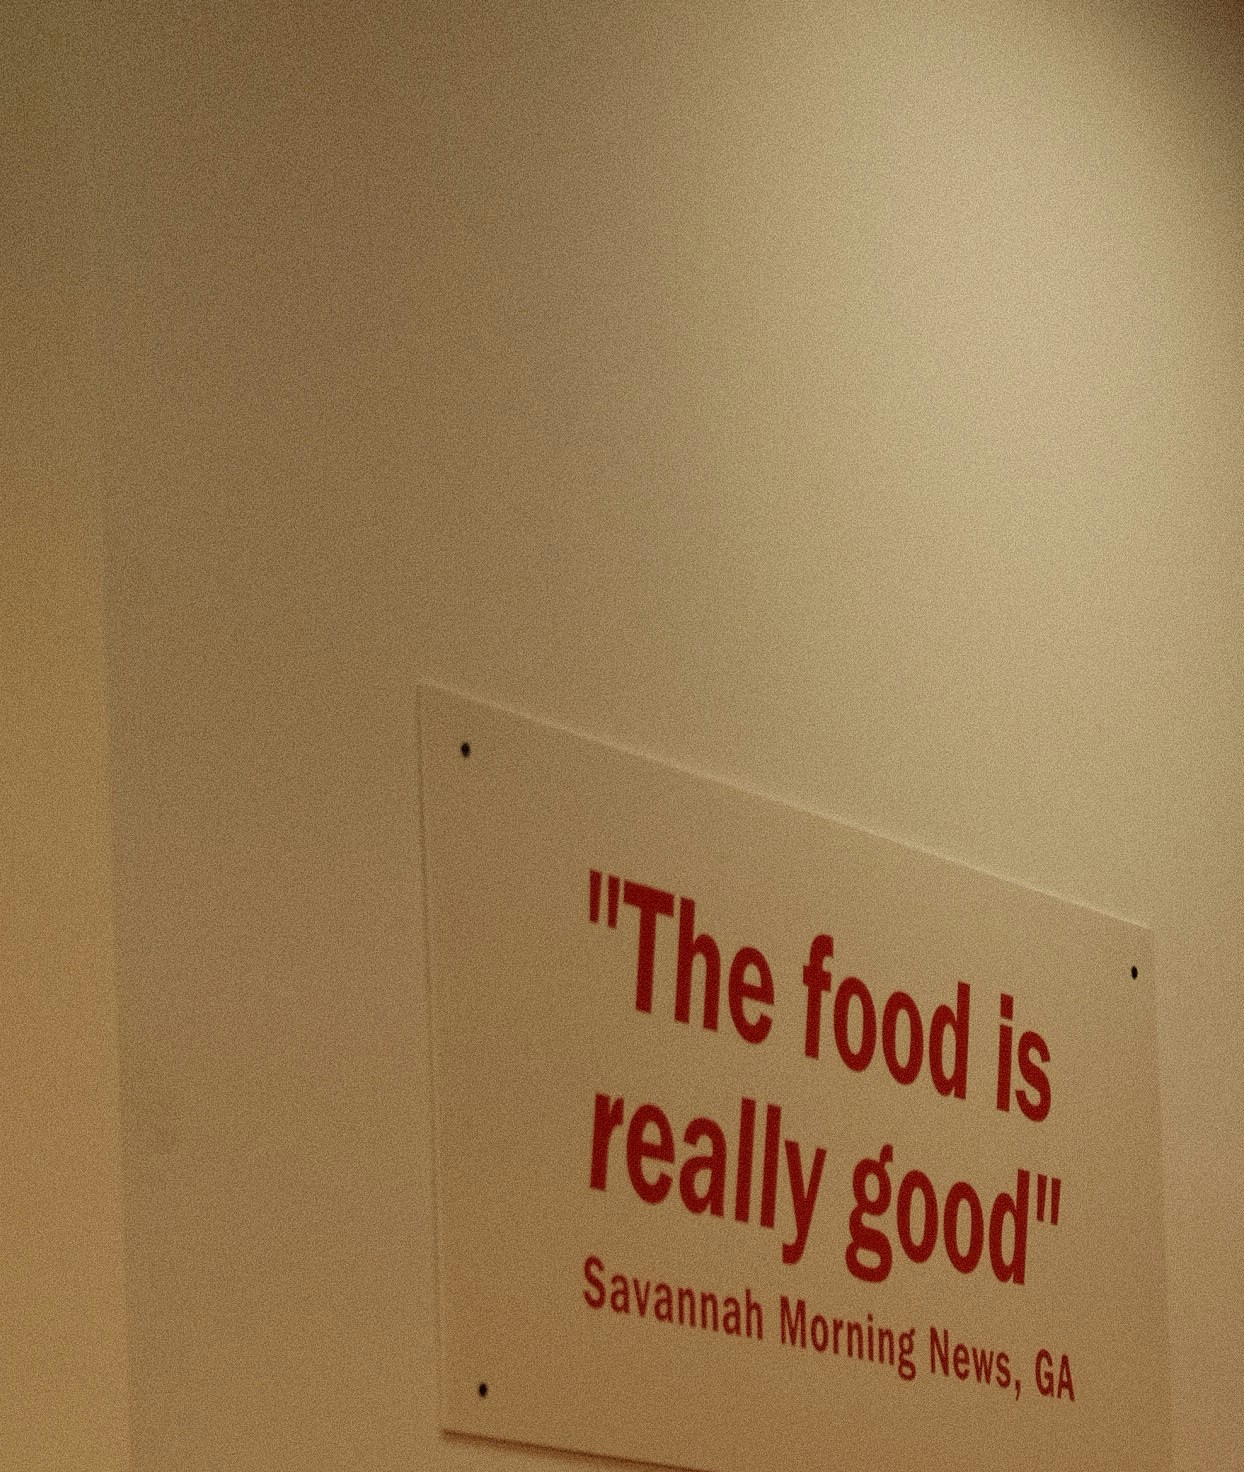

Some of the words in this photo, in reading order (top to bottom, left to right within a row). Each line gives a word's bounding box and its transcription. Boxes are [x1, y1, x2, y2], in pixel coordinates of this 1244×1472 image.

[589, 870, 775, 1045] "The
[802, 934, 970, 1099] food
[996, 994, 1051, 1122] is
[589, 1093, 826, 1265] really
[845, 1144, 1061, 1285] good"
[583, 1256, 764, 1339] Savannah
[780, 1296, 916, 1381] Morning
[930, 1328, 1022, 1401] News,
[1035, 1349, 1075, 1402] GA
